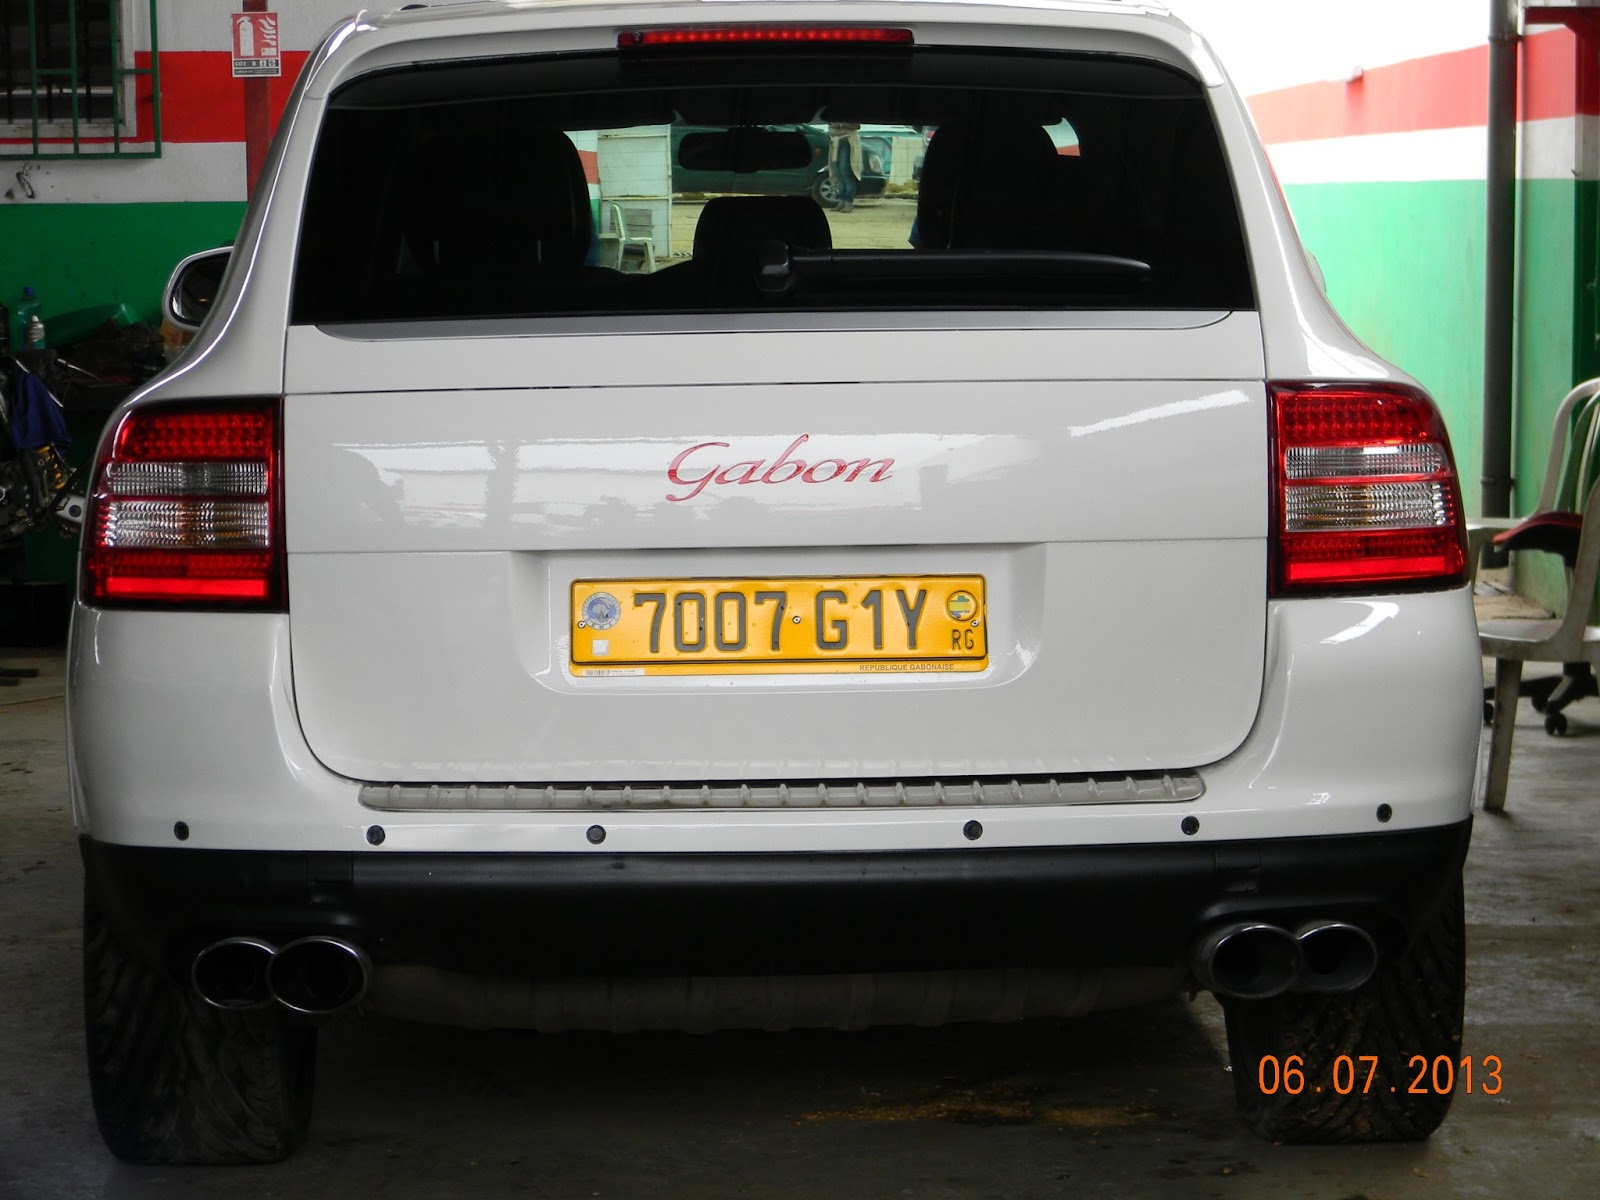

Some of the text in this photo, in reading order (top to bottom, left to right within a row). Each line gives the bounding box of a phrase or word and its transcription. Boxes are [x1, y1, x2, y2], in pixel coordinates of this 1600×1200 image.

[665, 433, 895, 502] Gabon
[634, 590, 787, 653] 7007
[815, 589, 927, 650] G1Y
[951, 629, 974, 650] RG
[859, 663, 955, 671] REPUBLIQUE GABONAISE
